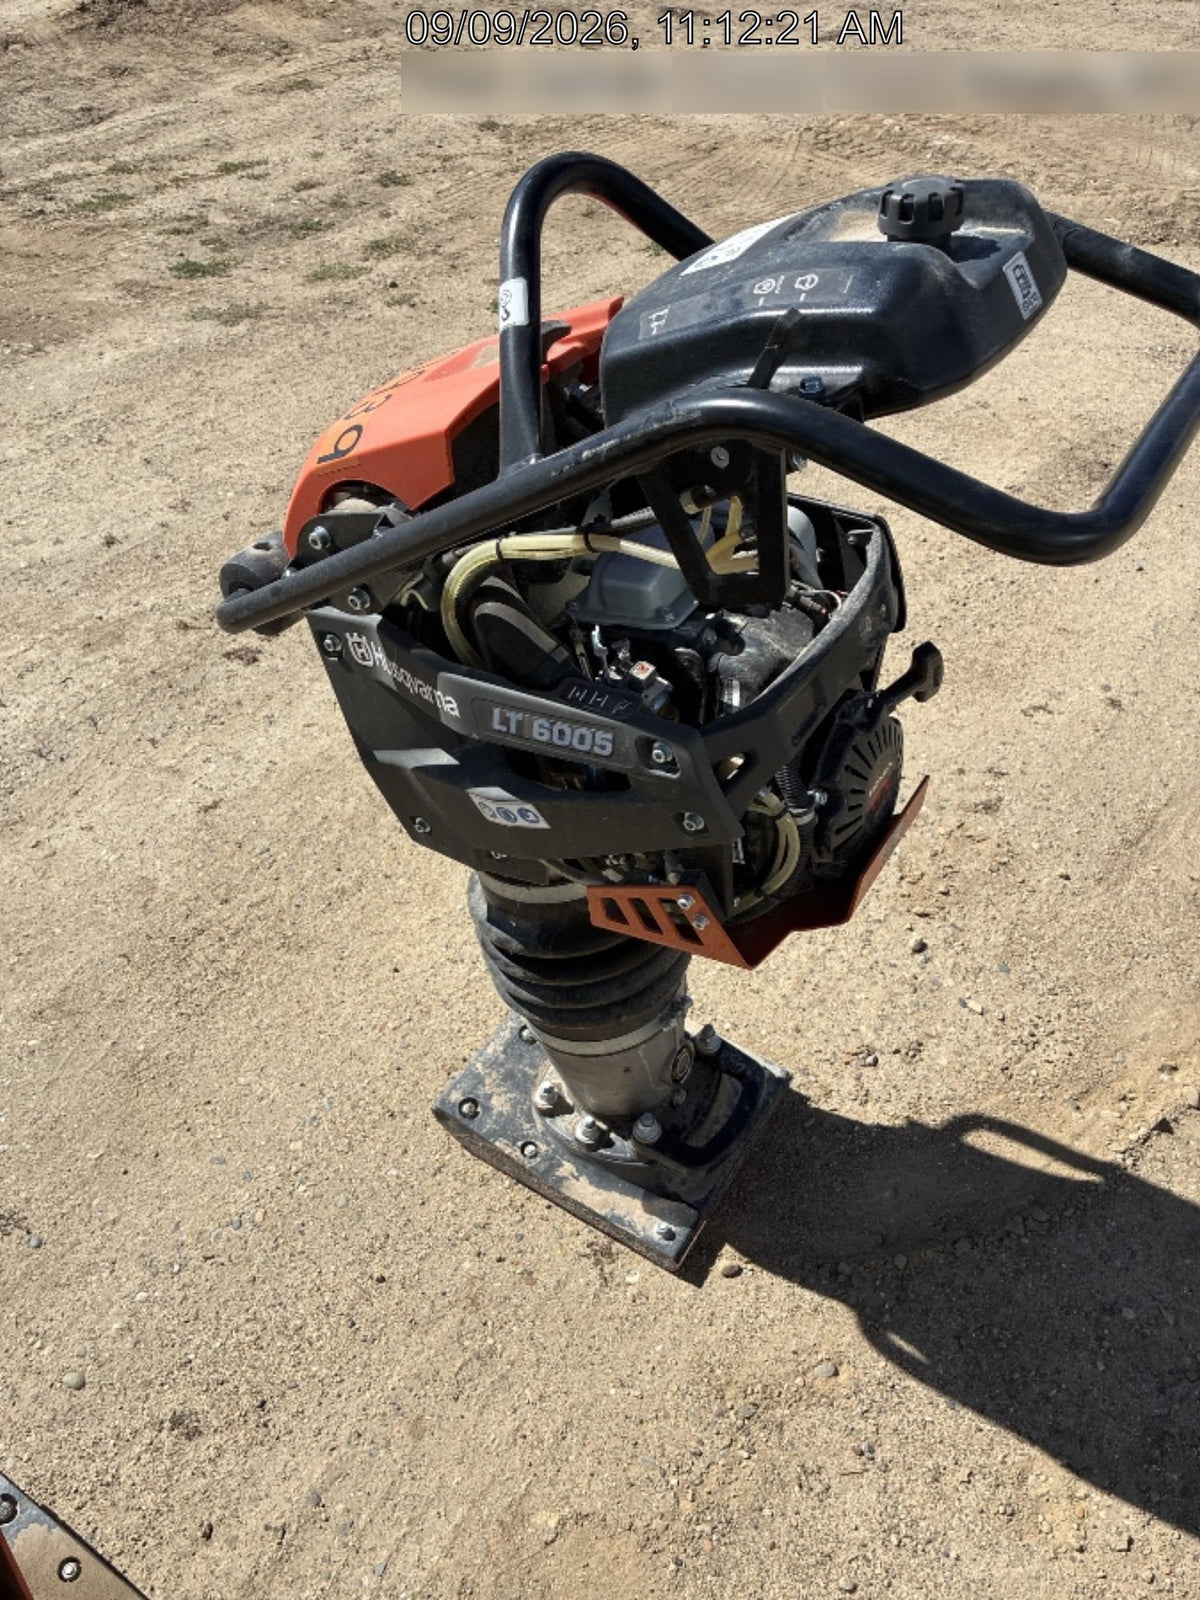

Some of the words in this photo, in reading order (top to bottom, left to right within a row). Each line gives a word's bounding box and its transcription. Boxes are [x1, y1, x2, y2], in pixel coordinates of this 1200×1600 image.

[369, 642, 460, 718] Husqvarna
[491, 706, 523, 735] LT
[532, 718, 615, 757] 6005
